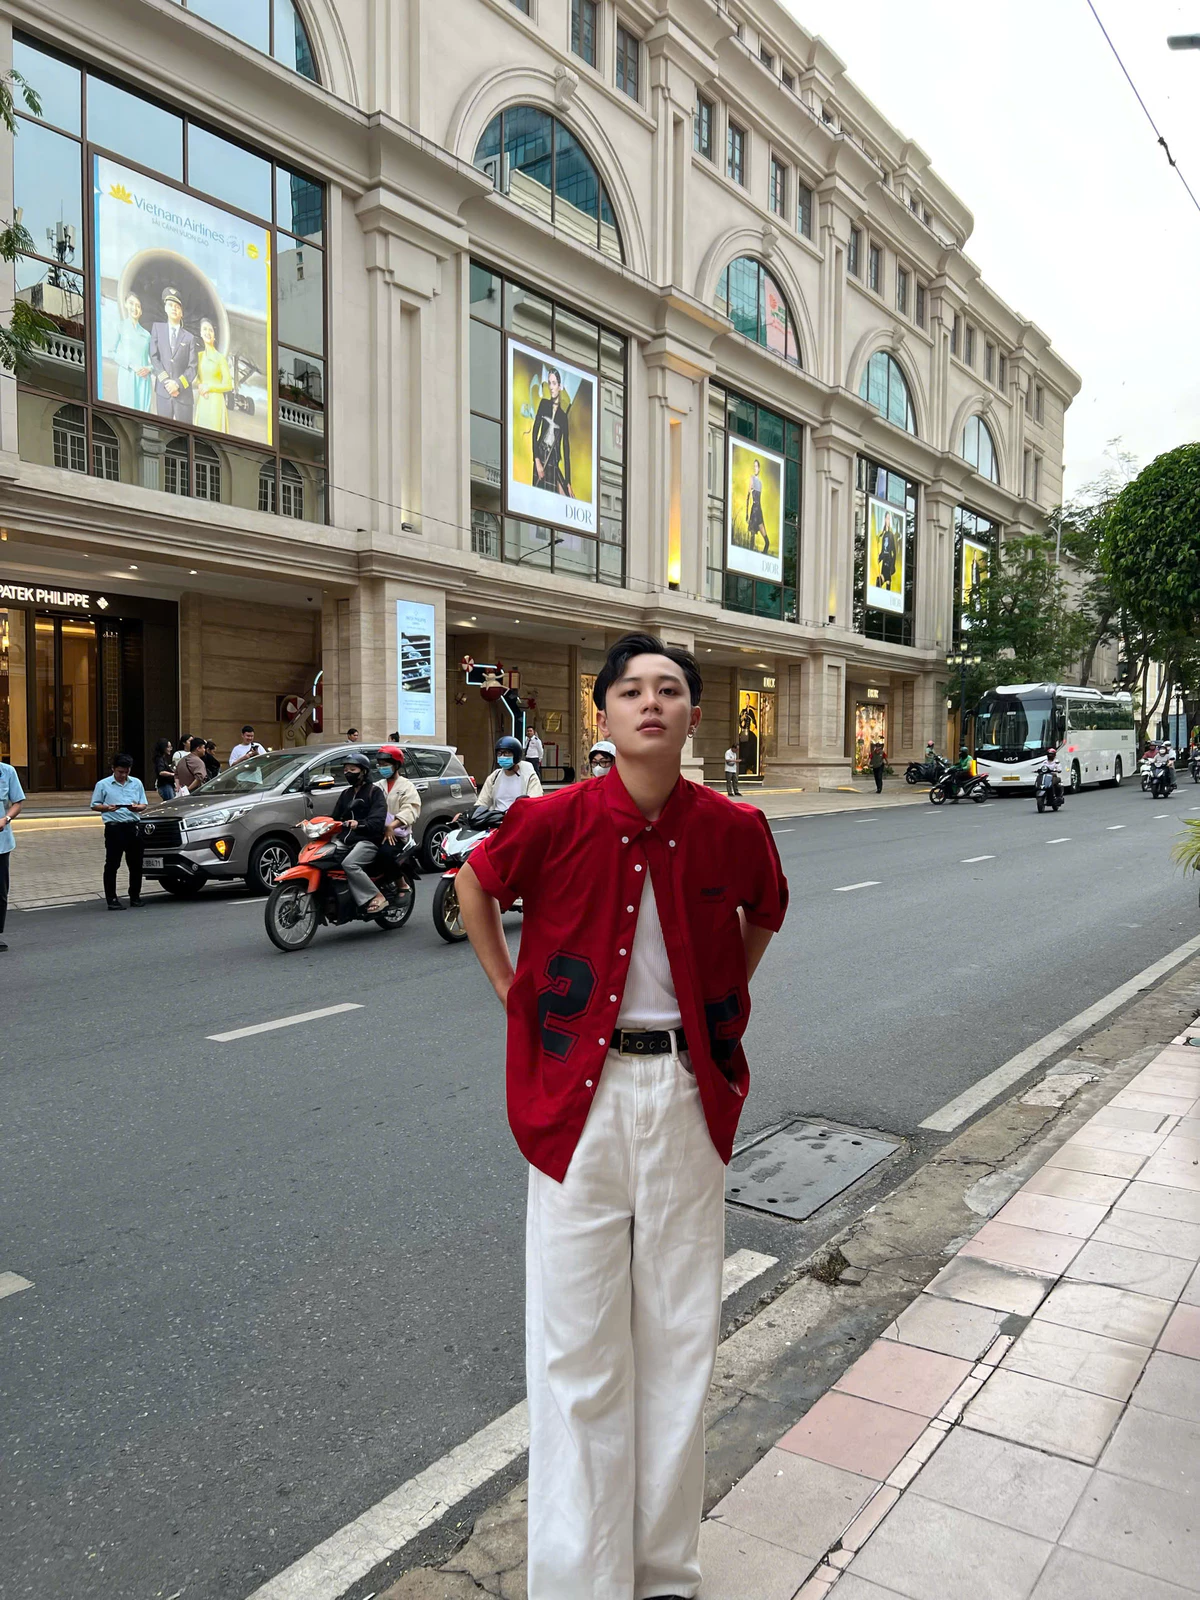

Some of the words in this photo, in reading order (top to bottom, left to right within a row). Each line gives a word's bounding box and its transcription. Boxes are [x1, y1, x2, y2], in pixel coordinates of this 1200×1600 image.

[134, 194, 183, 226] Vietnam
[183, 217, 225, 244] Airlines
[565, 504, 593, 526] DIOR
[761, 560, 780, 576] DIOR
[36, 588, 90, 608] PHILIPPE
[537, 950, 599, 1064] 2
